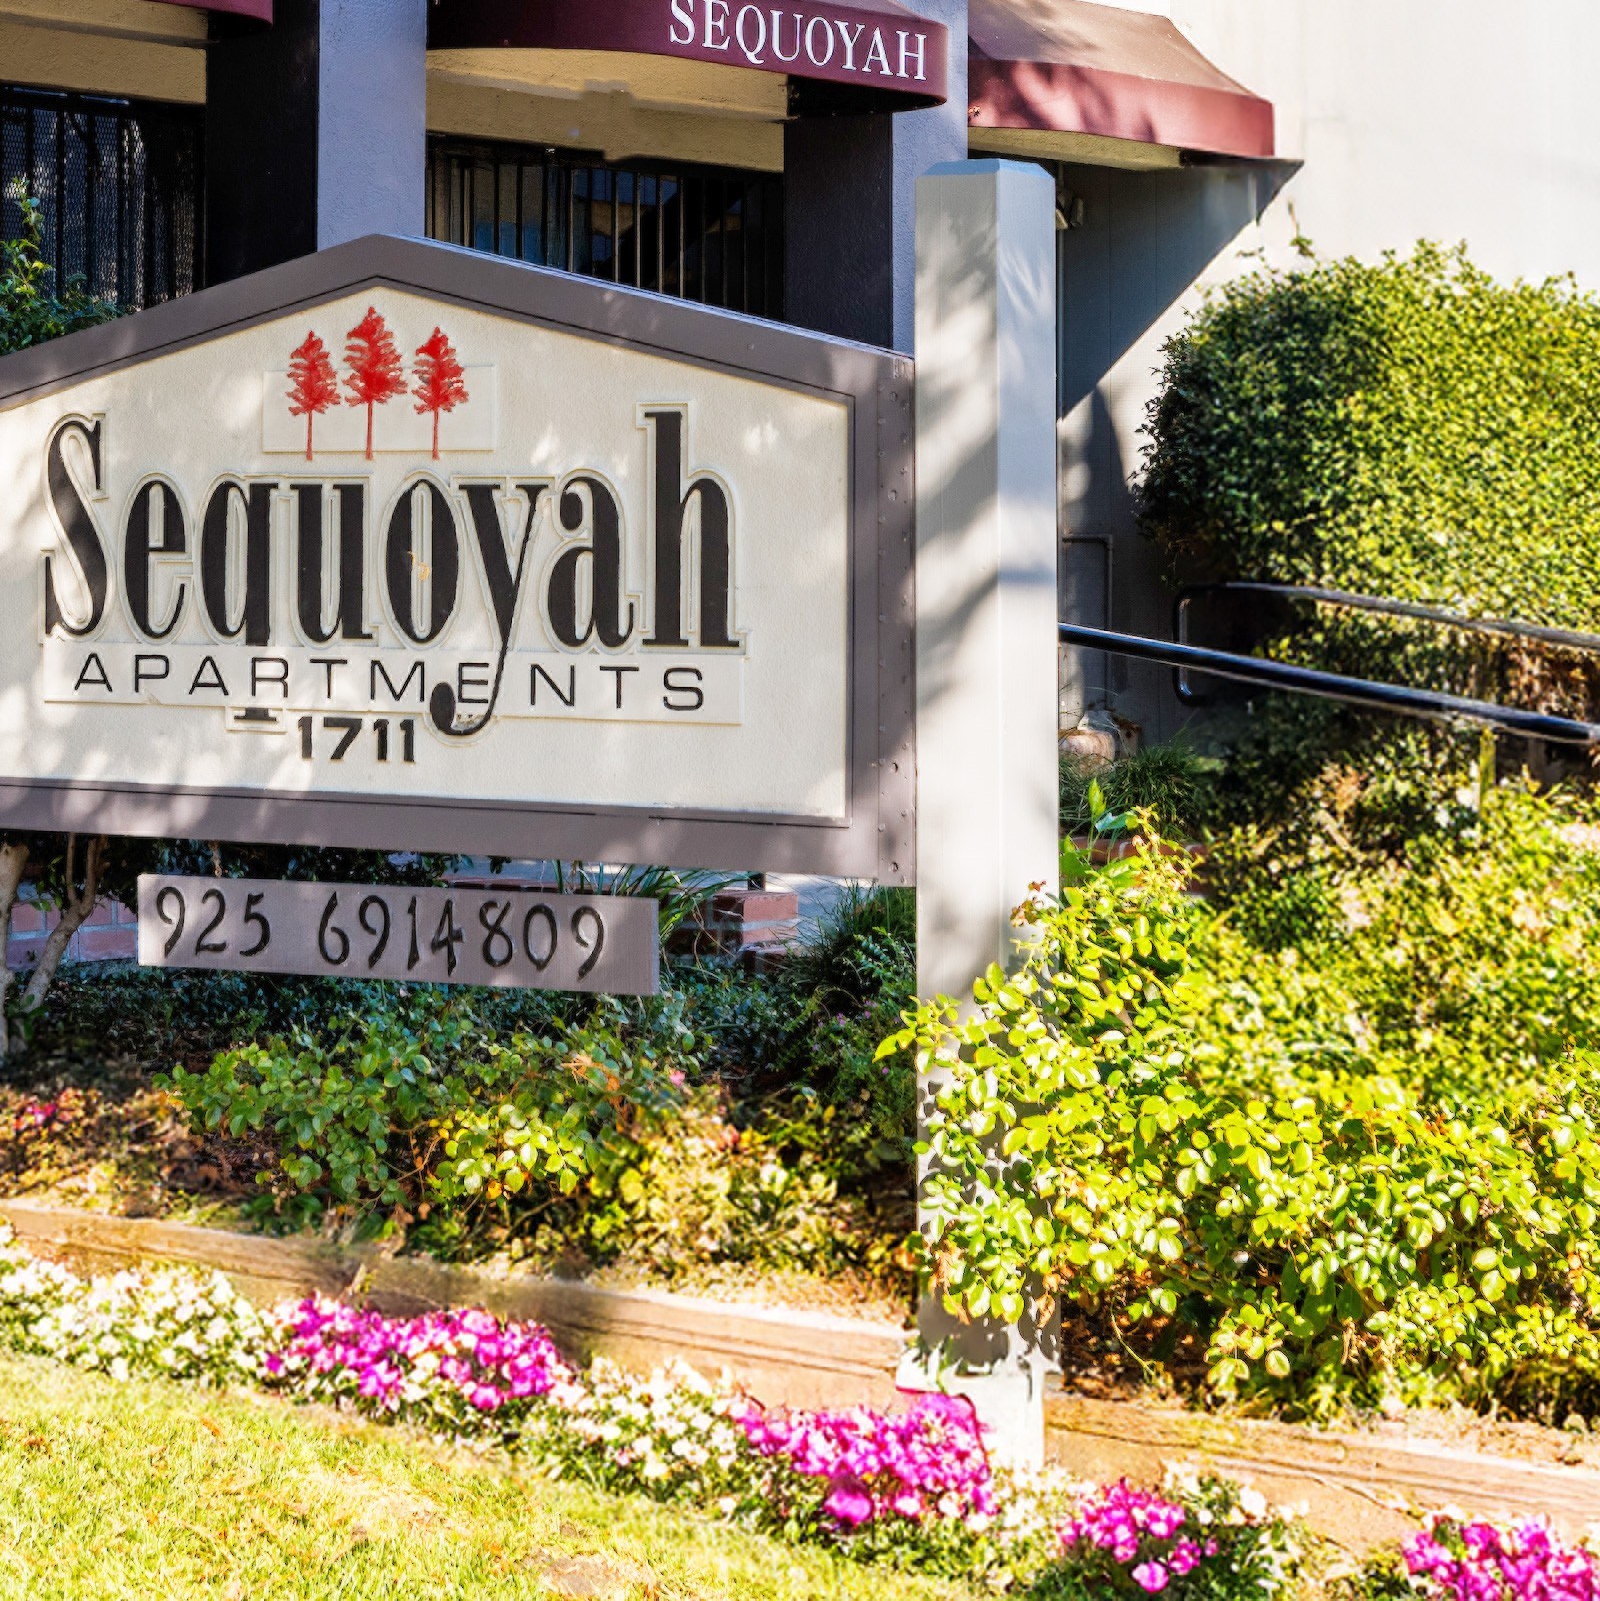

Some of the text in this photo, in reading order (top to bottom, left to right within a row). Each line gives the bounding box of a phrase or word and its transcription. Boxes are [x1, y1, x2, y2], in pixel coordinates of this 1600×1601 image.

[45, 411, 740, 736] Sequoyah
[75, 653, 705, 711] APARTMENTS
[298, 717, 416, 763] 1711
[155, 886, 606, 979] 925 6914809
